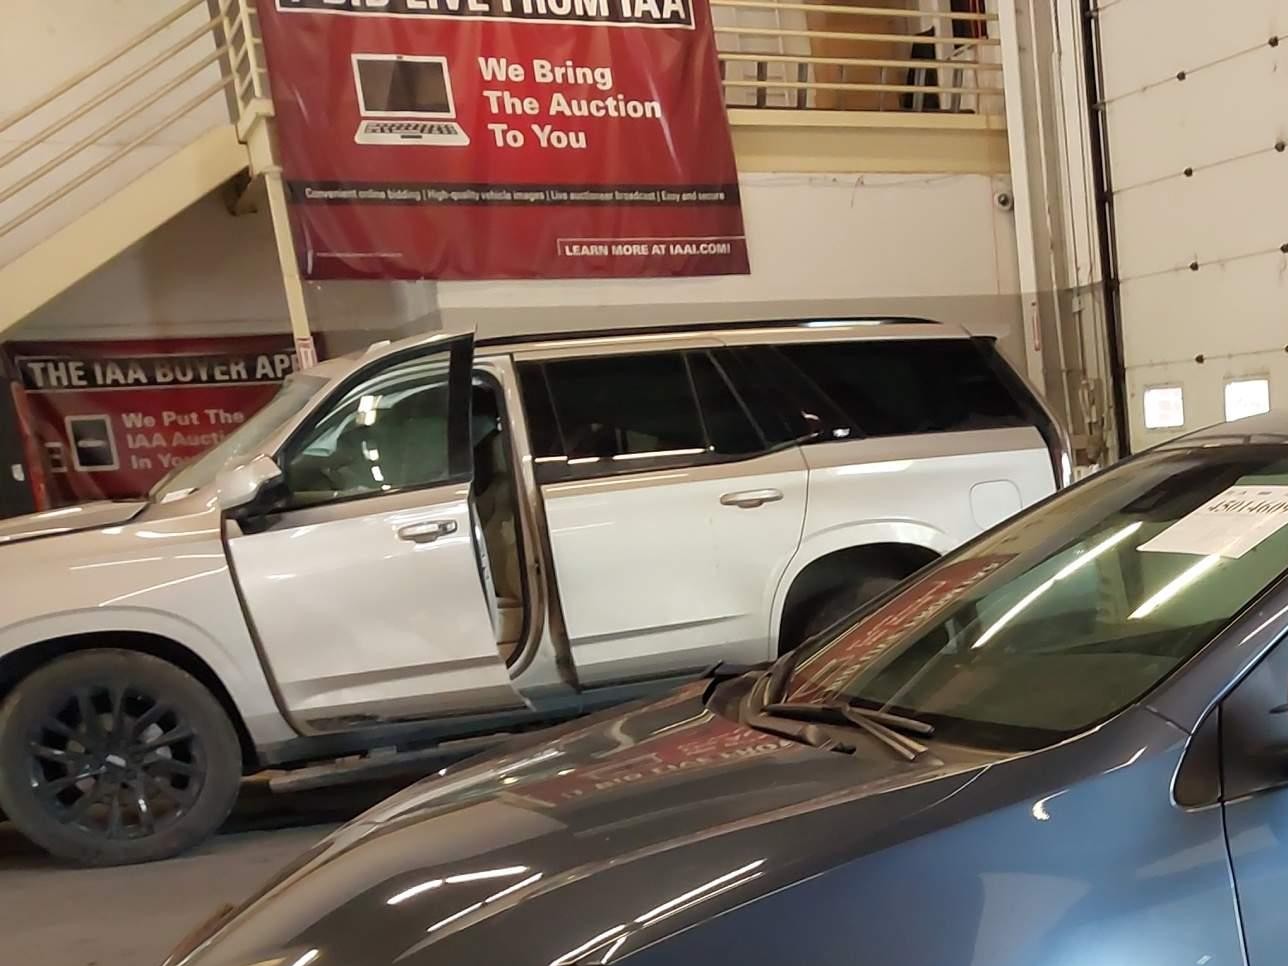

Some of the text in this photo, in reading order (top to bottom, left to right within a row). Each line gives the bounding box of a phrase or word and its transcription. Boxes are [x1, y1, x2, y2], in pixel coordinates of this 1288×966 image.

[621, 0, 686, 19] IAA
[478, 57, 613, 90] We Bring
[483, 90, 662, 118] The Auction
[488, 123, 587, 149] To You
[565, 245, 608, 256] LEARN
[612, 244, 649, 256] MORE
[651, 244, 667, 256] AT
[27, 361, 88, 388] THE
[94, 362, 148, 385] IAA
[154, 359, 248, 383] BUYER
[122, 408, 244, 428] We Put The
[126, 432, 167, 449] IAA
[131, 455, 152, 469] In
